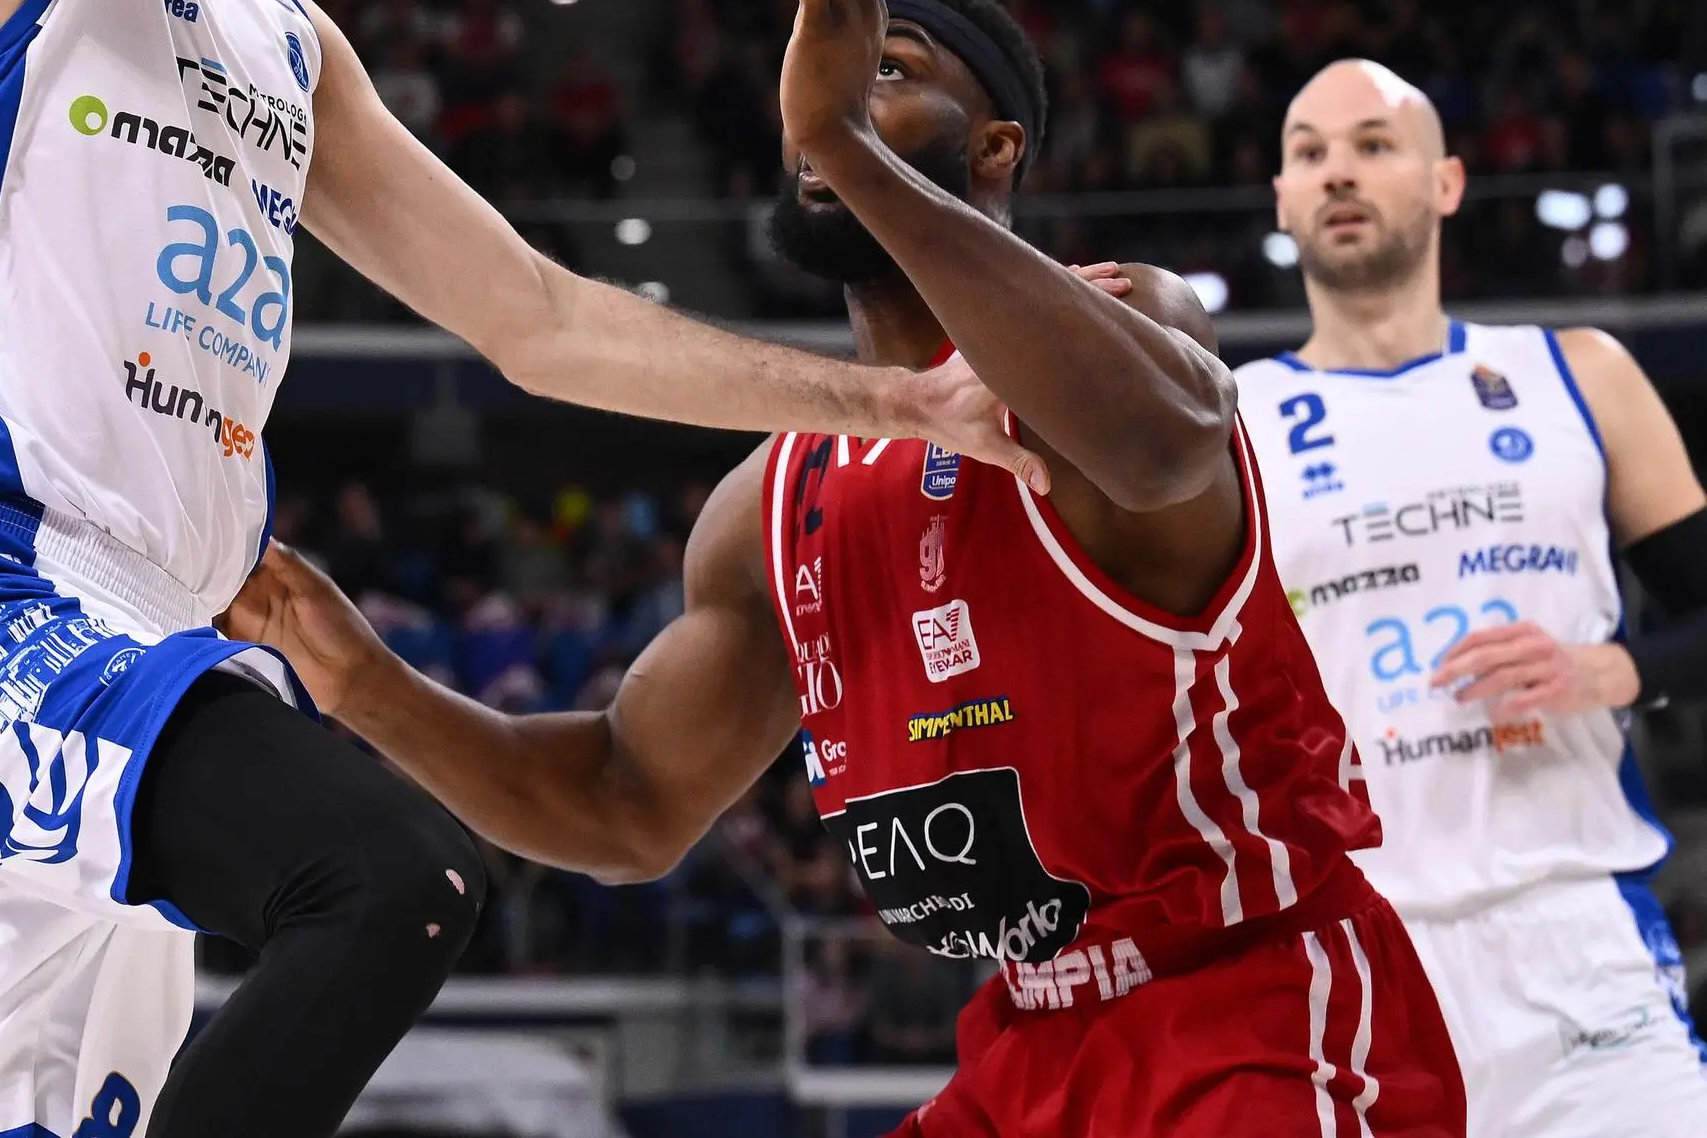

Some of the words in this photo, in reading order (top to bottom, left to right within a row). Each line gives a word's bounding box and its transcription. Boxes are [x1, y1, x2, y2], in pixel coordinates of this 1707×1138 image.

[250, 83, 307, 124] MTROLOG
[157, 205, 290, 351] a2a
[145, 301, 196, 341] LIFE
[1279, 393, 1334, 455] 2
[932, 475, 956, 489] Unipo
[1333, 490, 1524, 547] TECHNE
[1311, 564, 1421, 606] mazza
[917, 607, 960, 650] EA7
[908, 700, 1013, 741] SIMMENTHAL
[822, 739, 846, 762] Gro
[848, 803, 976, 880] EAQ
[949, 893, 975, 911] DI
[999, 936, 1153, 1010] LIMPIA
